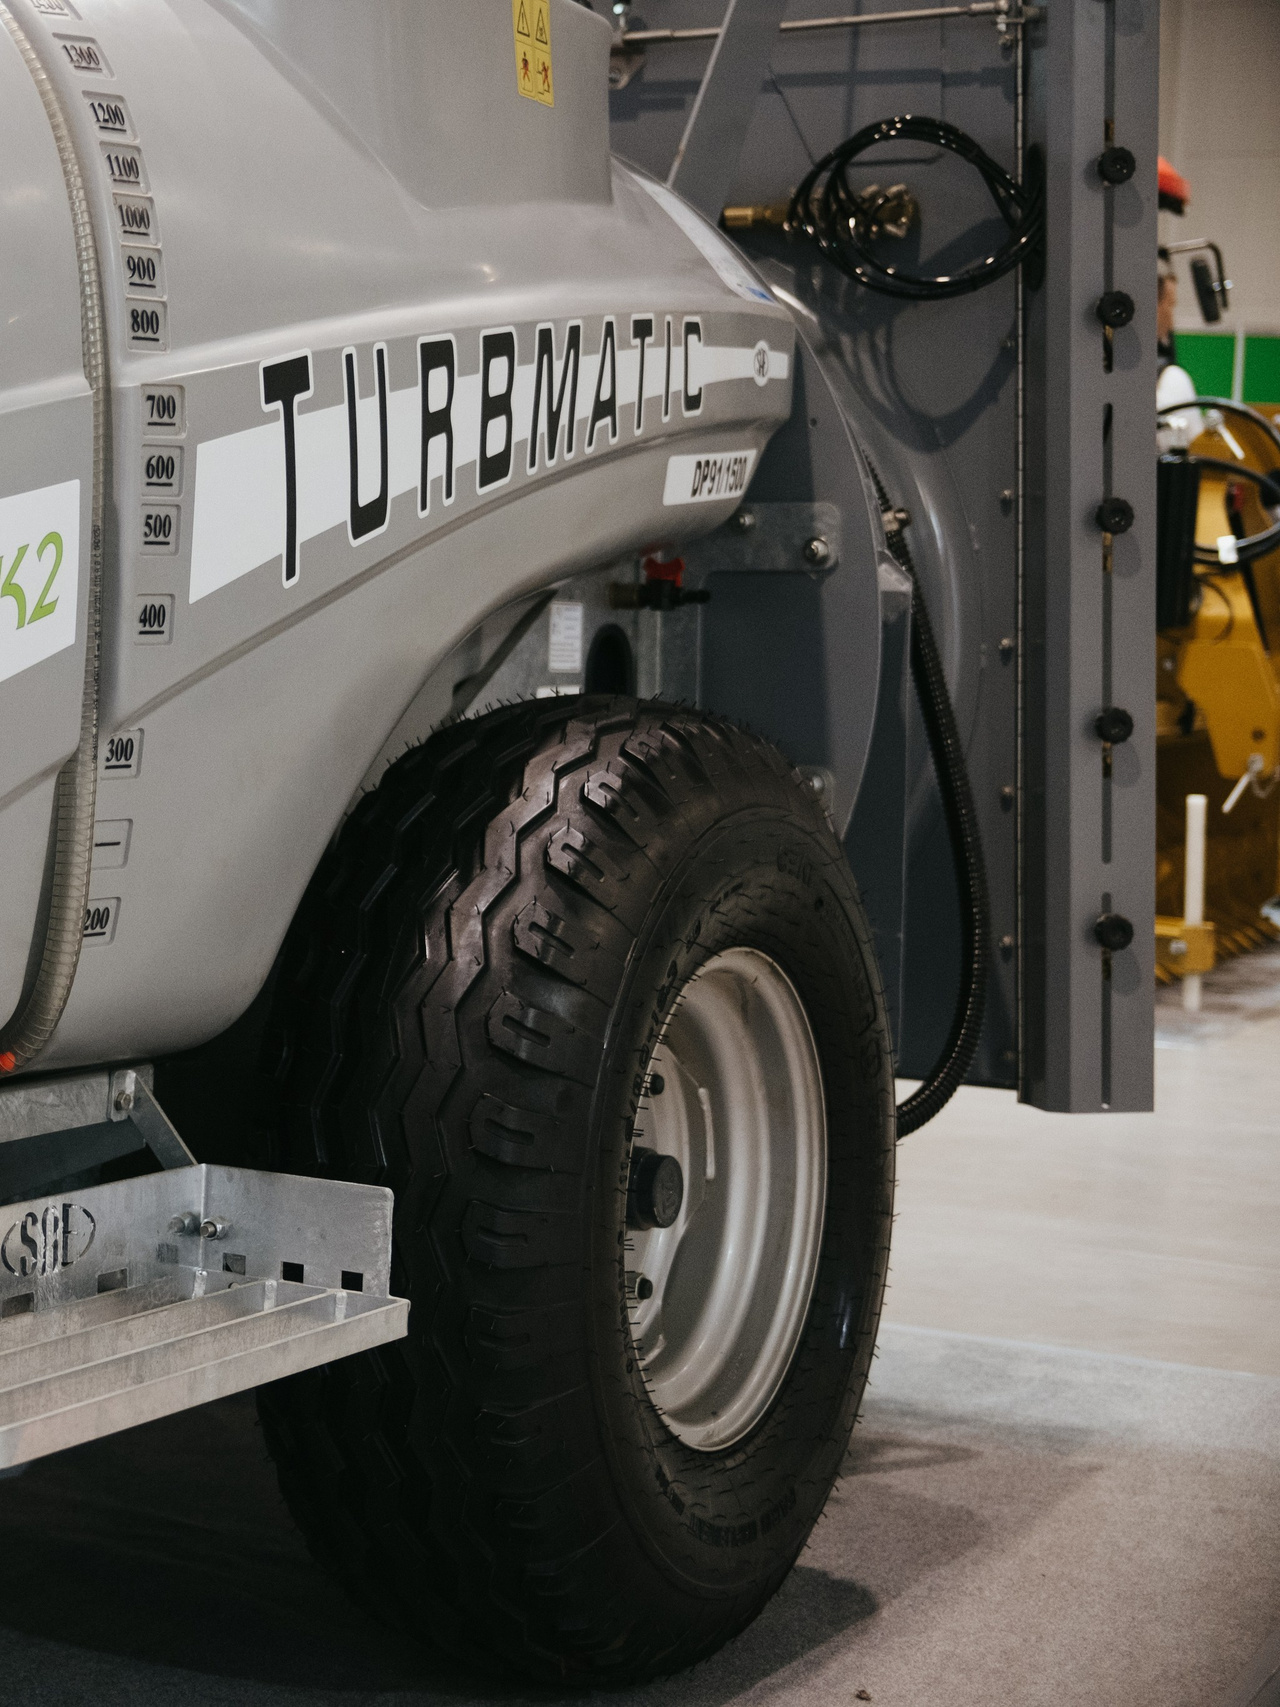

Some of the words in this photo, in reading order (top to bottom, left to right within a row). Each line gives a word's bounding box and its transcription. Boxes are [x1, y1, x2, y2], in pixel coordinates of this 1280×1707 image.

[62, 44, 100, 66] 1300
[90, 102, 125, 126] 1200
[106, 153, 140, 179] 1100
[118, 204, 151, 230] 1000
[127, 255, 156, 281] 900
[131, 308, 160, 335] 800
[146, 395, 177, 420] 700
[261, 316, 704, 584] TURBMATIC
[145, 455, 175, 480] 600
[690, 457, 748, 498] DP91/1500
[144, 514, 172, 539] 500
[138, 603, 167, 629] 400
[104, 737, 135, 763] 300
[83, 906, 111, 931] 200
